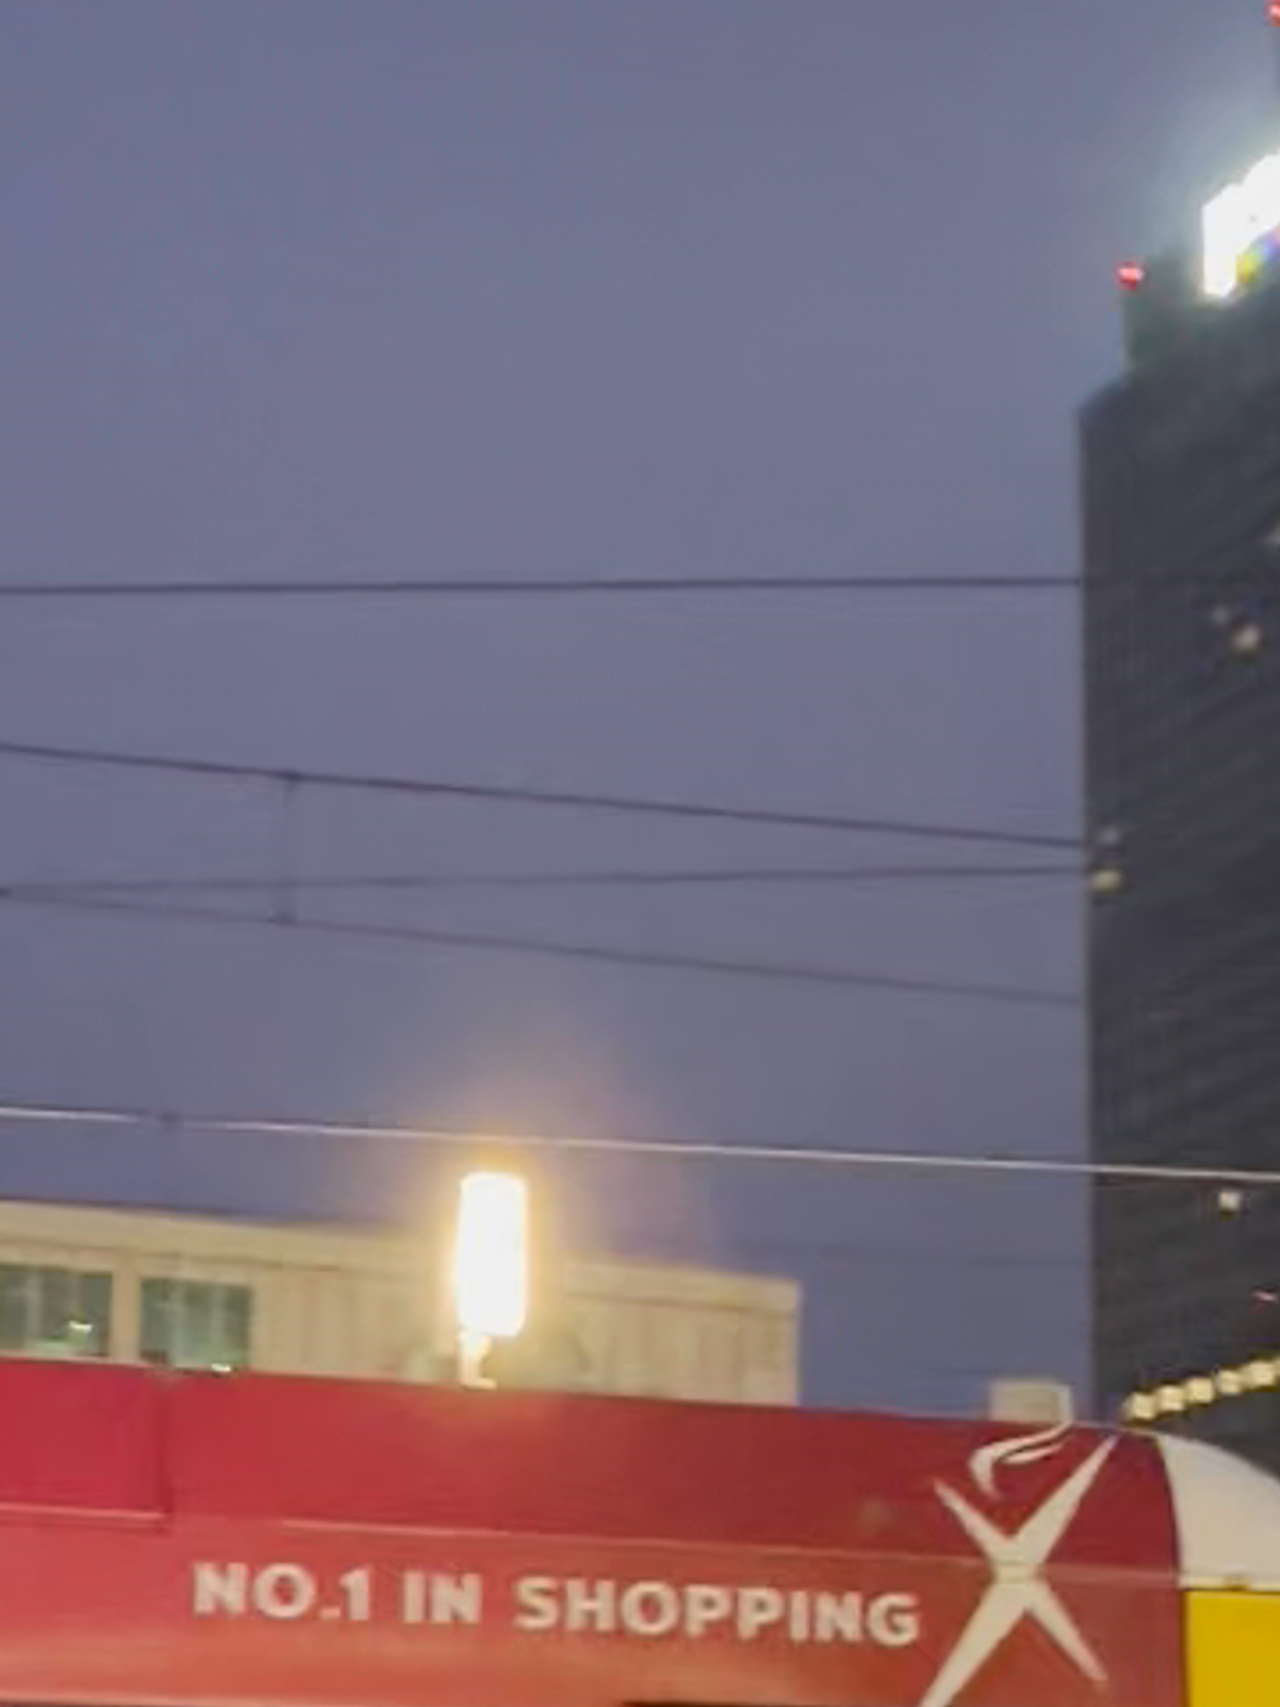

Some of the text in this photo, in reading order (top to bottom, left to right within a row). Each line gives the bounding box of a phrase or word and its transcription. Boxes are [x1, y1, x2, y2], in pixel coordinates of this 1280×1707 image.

[194, 1562, 919, 1646] NO.1 IN SHOPPING
